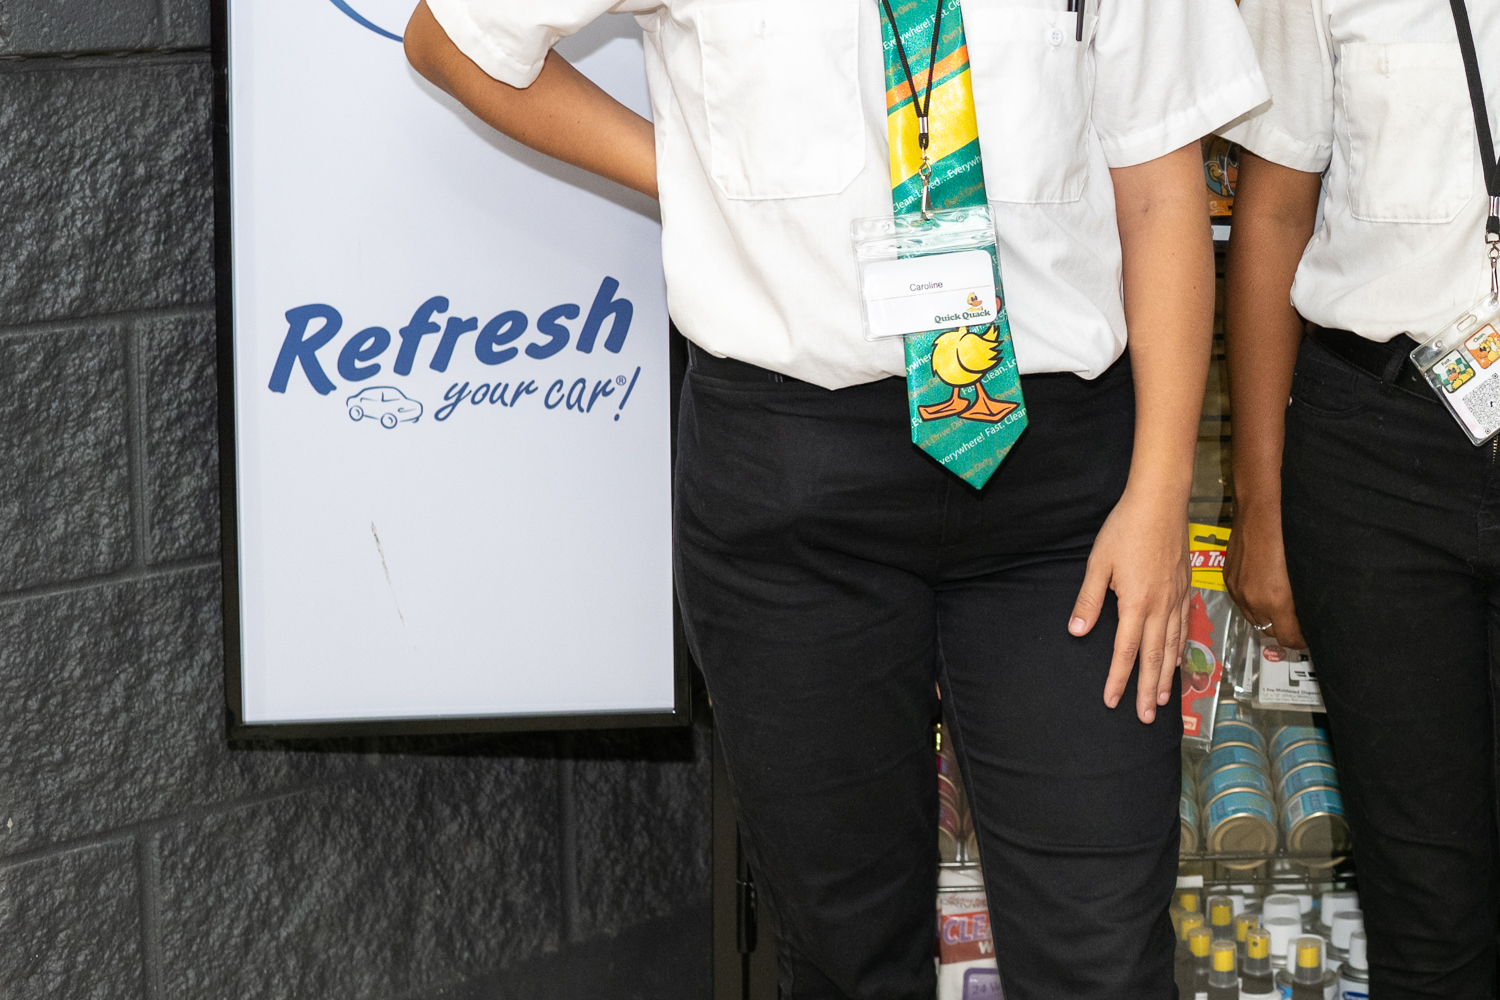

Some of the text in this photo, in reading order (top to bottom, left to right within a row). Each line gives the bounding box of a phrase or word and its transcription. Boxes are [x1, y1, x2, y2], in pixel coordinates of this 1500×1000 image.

[909, 281, 943, 292] Caroline
[268, 276, 634, 395] Refresh
[934, 309, 991, 324] Quick Quack
[434, 380, 539, 421] your
[937, 423, 1005, 464] verywhere! Fast.
